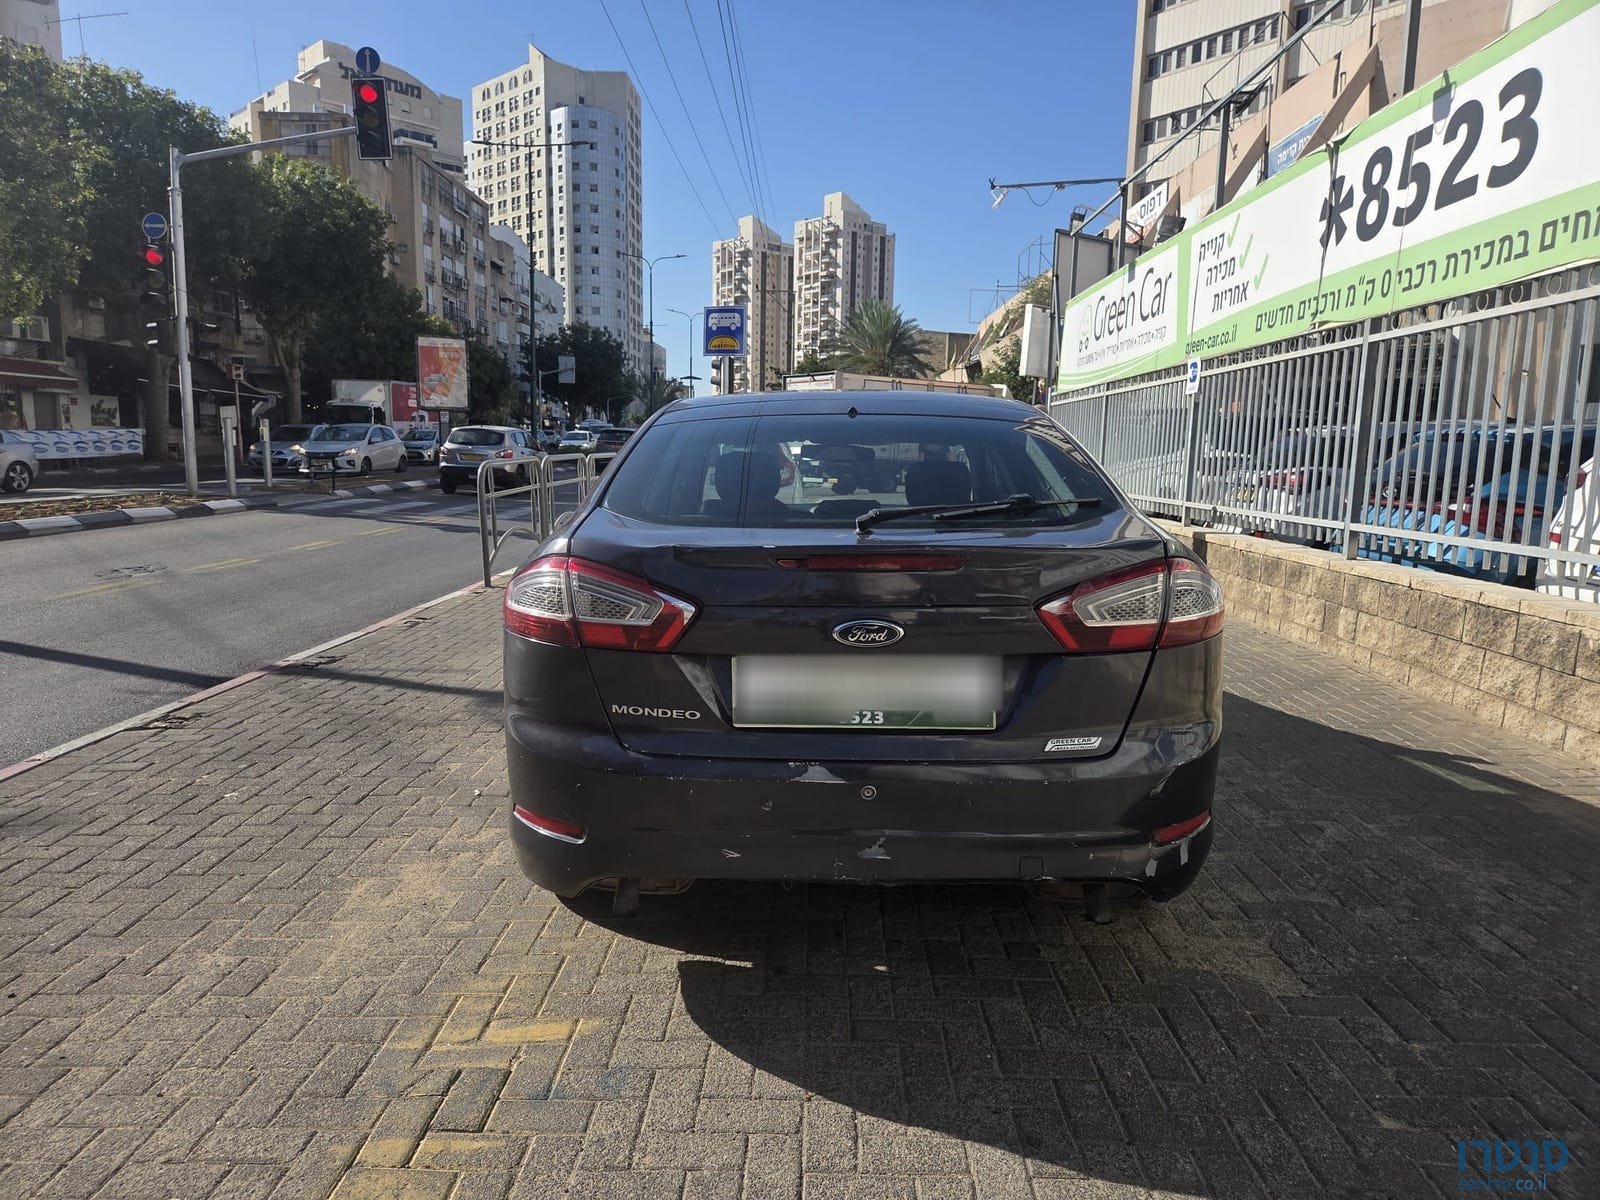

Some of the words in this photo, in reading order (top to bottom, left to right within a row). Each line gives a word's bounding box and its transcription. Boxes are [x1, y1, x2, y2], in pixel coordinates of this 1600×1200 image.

[1140, 190, 1162, 219] דפוס
[1442, 229, 1530, 281] במכירת
[1205, 256, 1236, 287] מכירה
[1380, 269, 1392, 298] 0
[1397, 259, 1437, 293] רכבי
[1093, 291, 1136, 341] Green
[1139, 267, 1172, 322] Car
[1211, 280, 1249, 313] אחריות
[1255, 303, 1294, 332] חדשים
[848, 625, 888, 642] Ford
[611, 704, 701, 720] MONDEO
